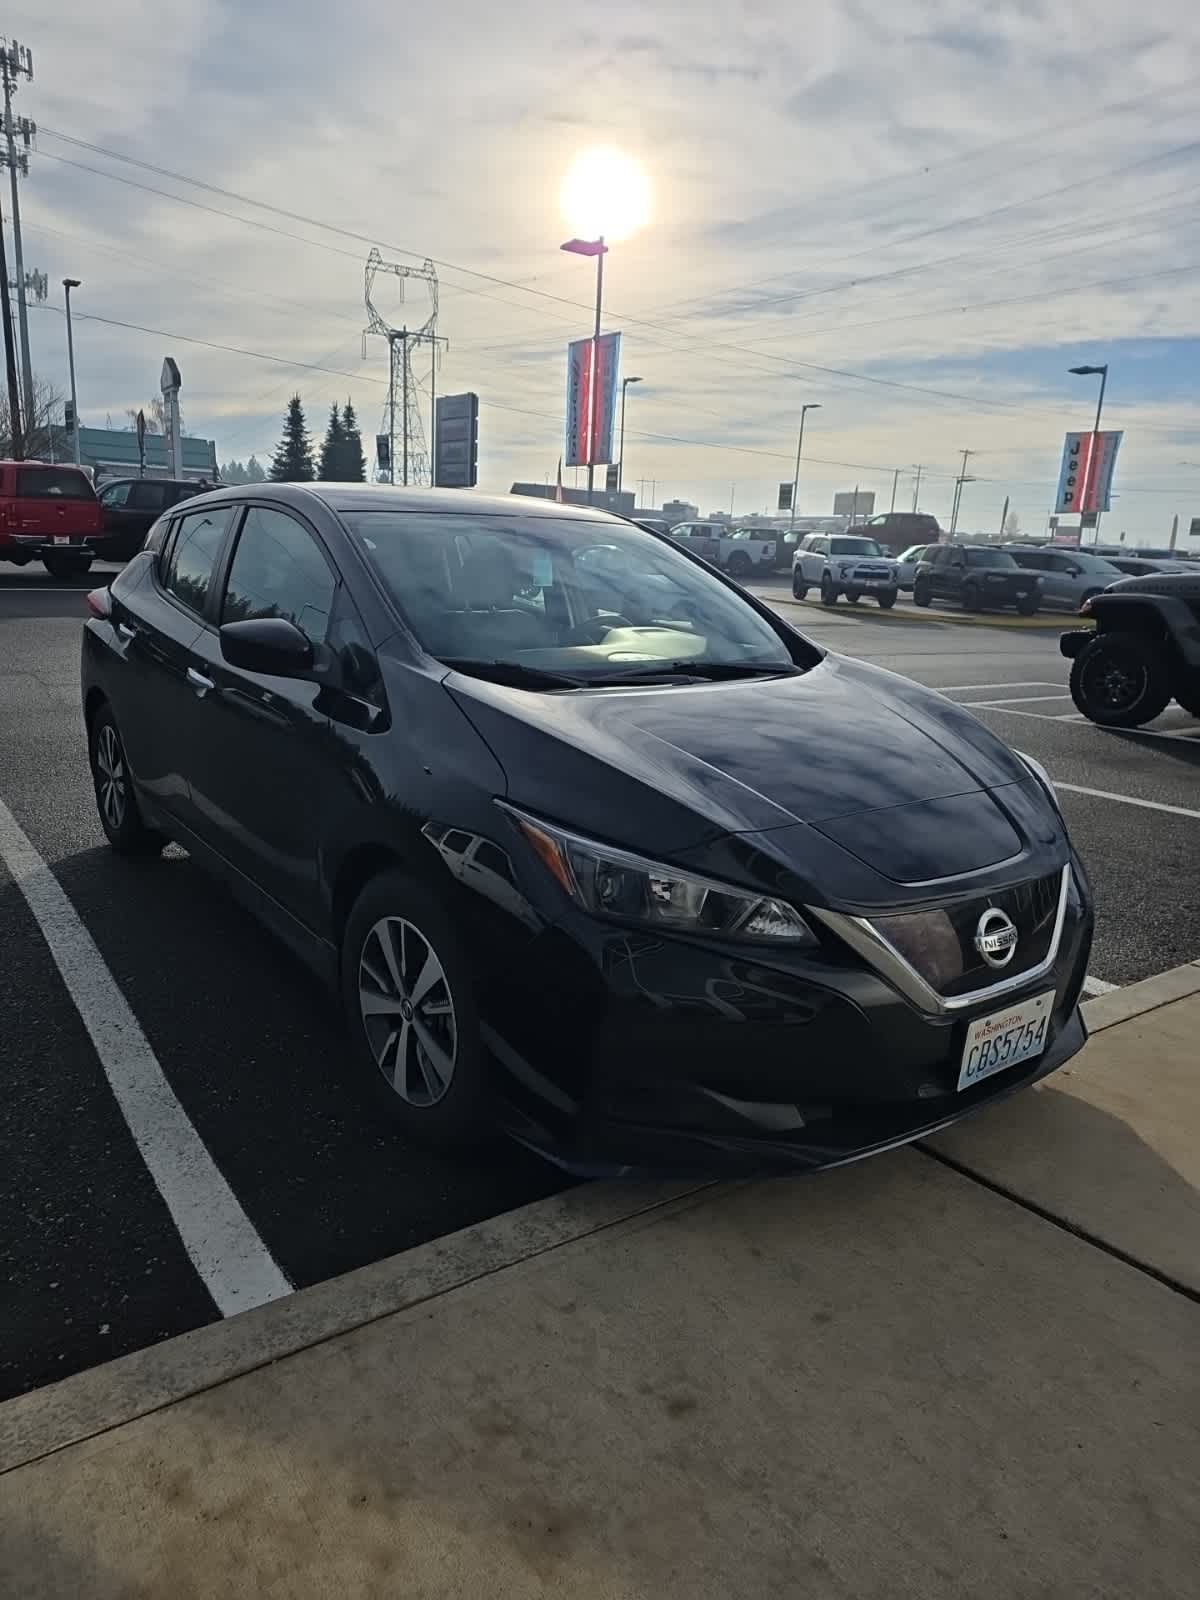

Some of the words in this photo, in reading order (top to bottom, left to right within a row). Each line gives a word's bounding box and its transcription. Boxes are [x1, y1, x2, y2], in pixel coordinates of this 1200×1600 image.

[1063, 441, 1081, 505] Jeep
[984, 933, 1017, 949] NISSAN
[966, 1016, 1047, 1078] CBS5754
[975, 1015, 1024, 1041] WASHINGTON
